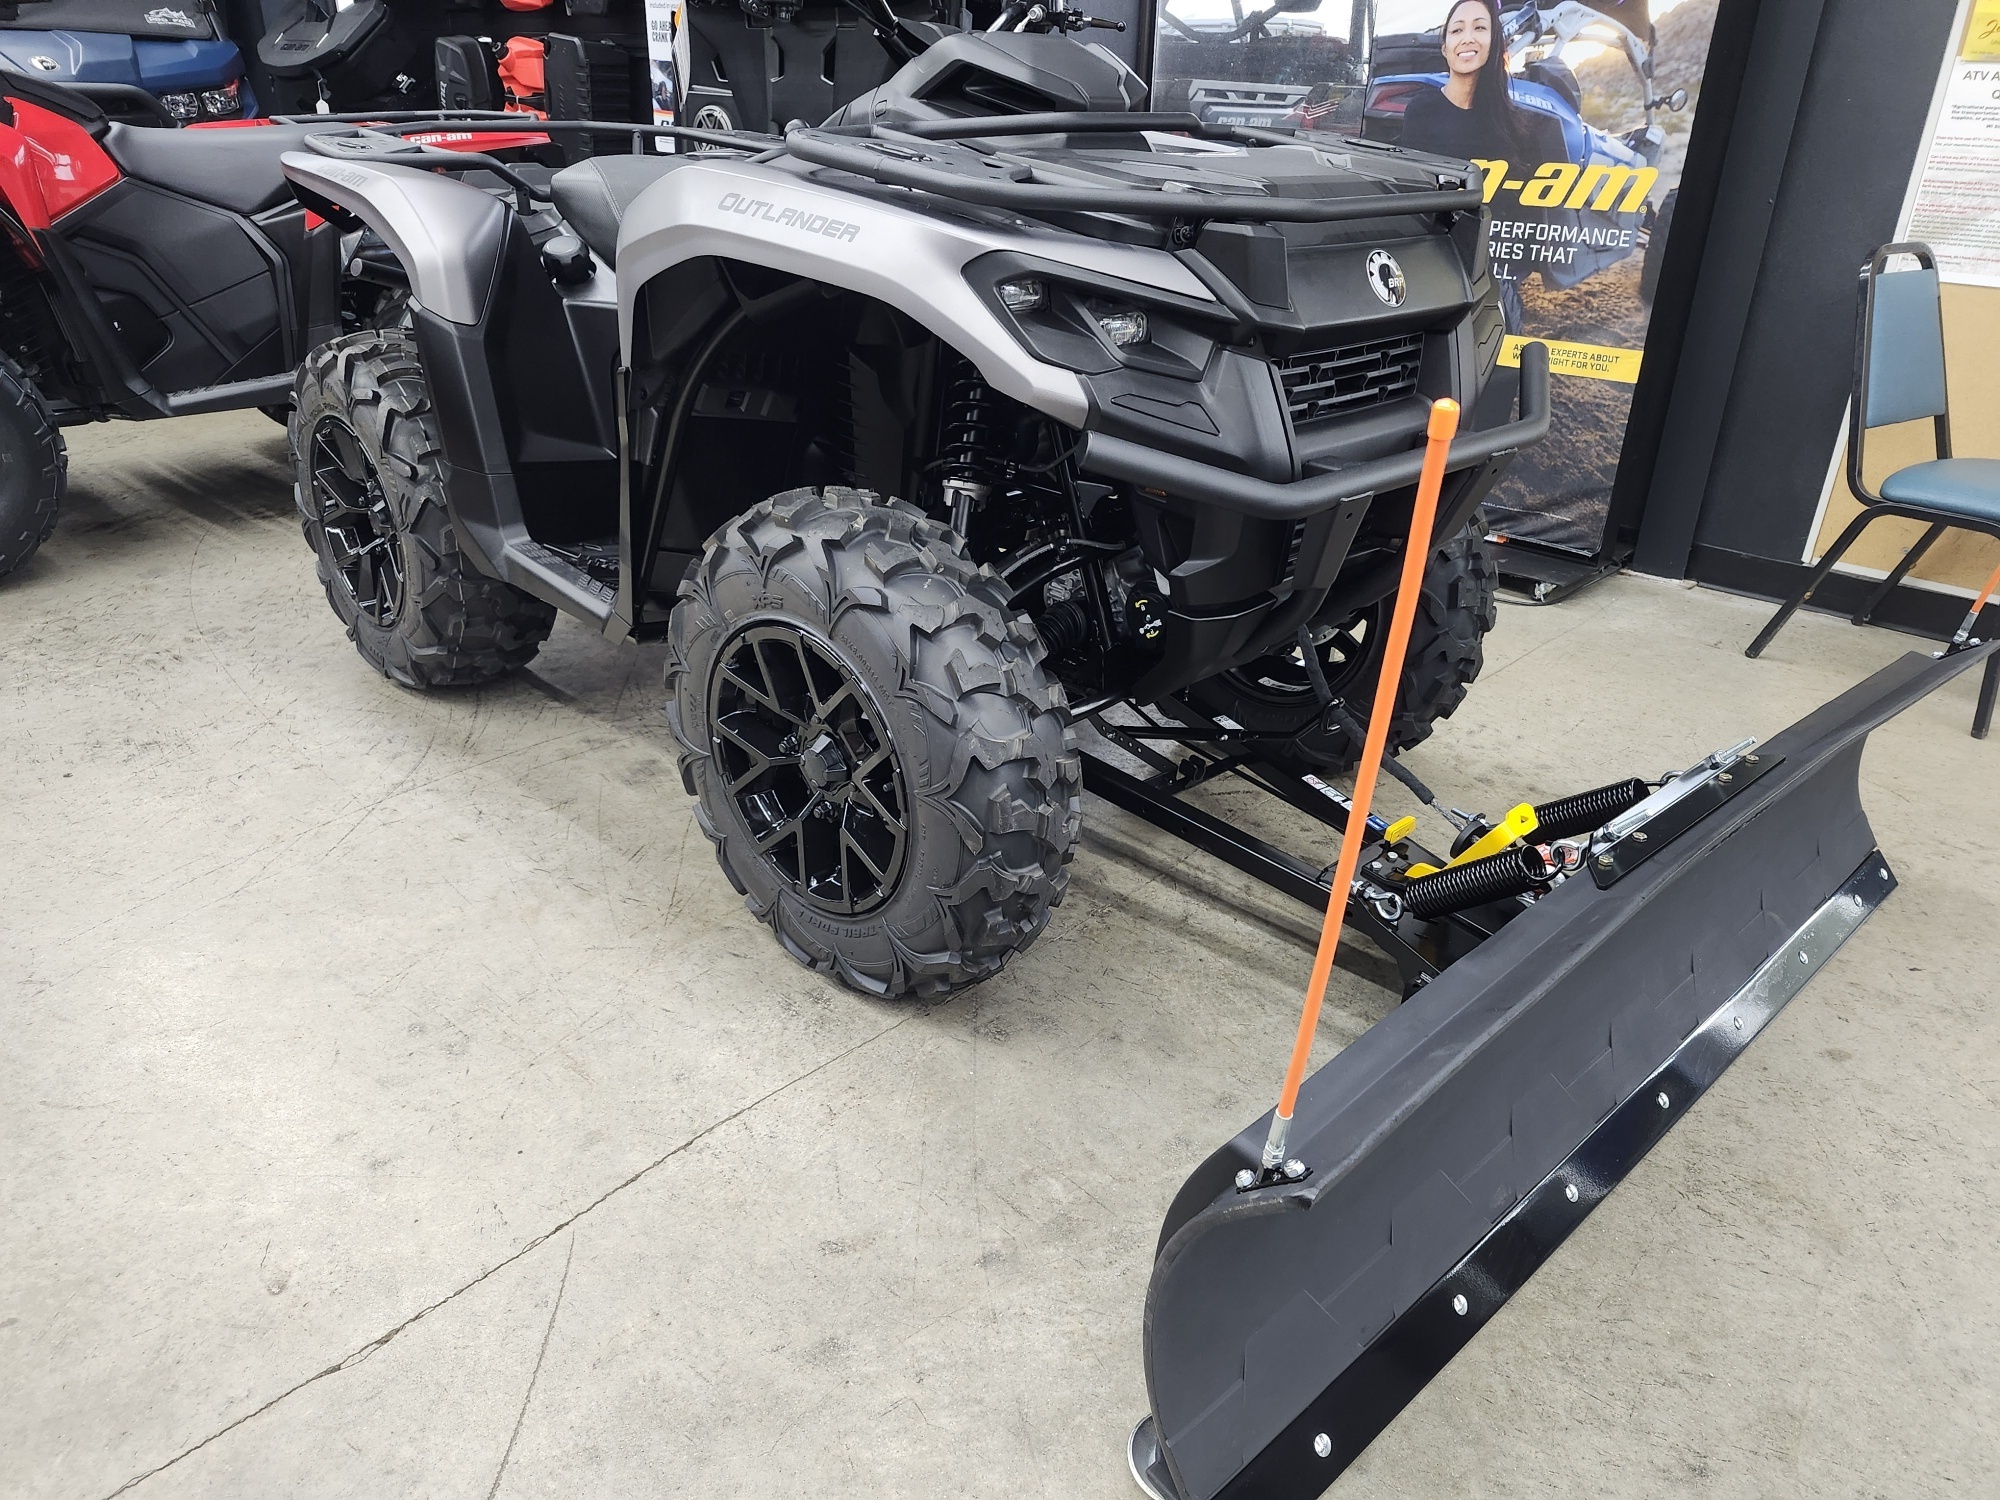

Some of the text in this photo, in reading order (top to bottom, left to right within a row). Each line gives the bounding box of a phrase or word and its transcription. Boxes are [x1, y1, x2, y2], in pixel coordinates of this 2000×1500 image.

[1963, 71, 1989, 80] ATV
[410, 132, 472, 144] can-am
[316, 164, 368, 187] can-am
[717, 192, 861, 243] OUTLANDER
[1489, 220, 1633, 248] PERFORMANCE
[1529, 244, 1578, 264] THAT
[1388, 277, 1404, 289] BRP
[1551, 348, 1588, 360] EXPERTS
[1589, 353, 1620, 363] ABOUT
[1571, 360, 1588, 369] FOR
[1590, 362, 1610, 372] YOU.
